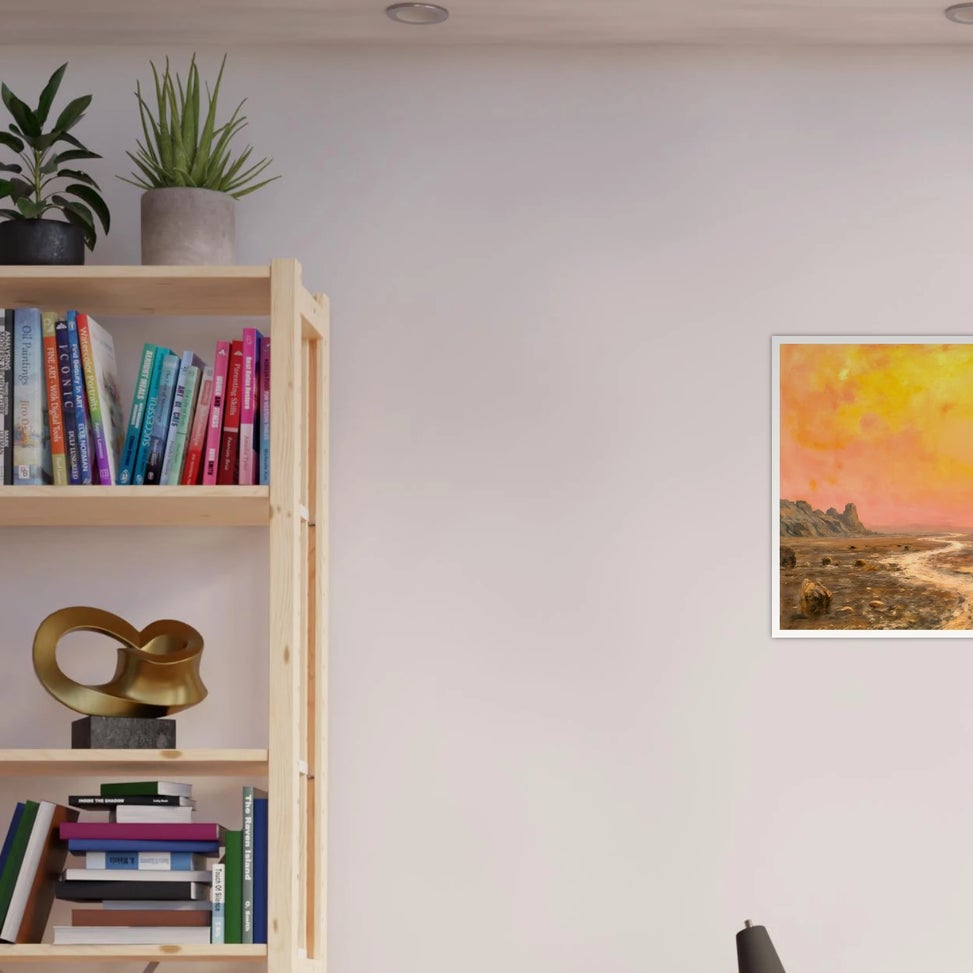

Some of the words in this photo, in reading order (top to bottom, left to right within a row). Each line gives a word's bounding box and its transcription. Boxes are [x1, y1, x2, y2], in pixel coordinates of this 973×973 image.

[22, 325, 33, 340] Oil
[18, 342, 32, 386] Paintings
[47, 347, 55, 364] FINE
[80, 326, 92, 373] Watercolor
[87, 375, 97, 411] Portraits
[48, 366, 57, 380] ART
[59, 344, 74, 408] ICONIC
[230, 363, 241, 397] Parenting
[49, 402, 60, 424] Digital
[229, 397, 237, 416] Skills
[53, 426, 62, 443] Tools
[142, 397, 156, 446] SUCCESSFUL
[79, 440, 88, 472] NORMAN
[244, 794, 252, 813] The
[244, 816, 252, 847] Raven
[214, 867, 222, 884] Touch
[244, 849, 252, 880] Island
